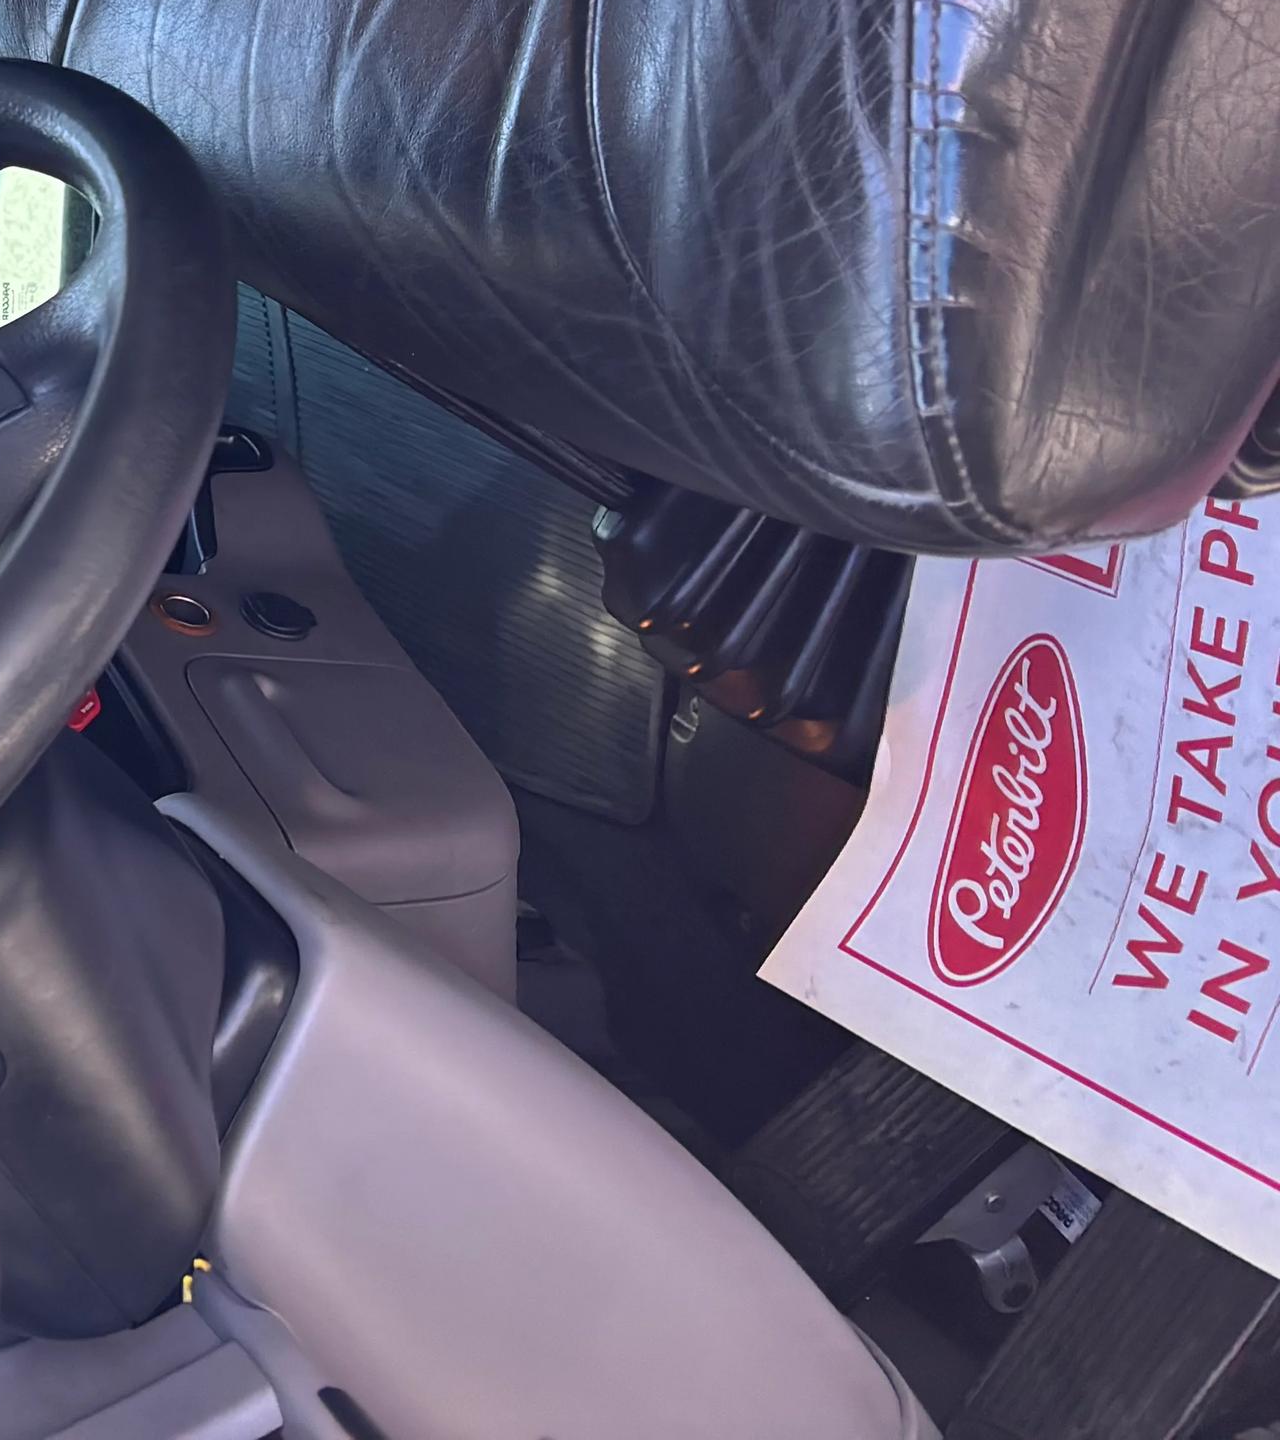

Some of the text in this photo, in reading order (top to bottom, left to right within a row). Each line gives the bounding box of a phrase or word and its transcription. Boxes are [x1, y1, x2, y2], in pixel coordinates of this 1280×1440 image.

[947, 657, 1058, 950] Peterbilt
[1111, 852, 1209, 990] WE
[1166, 606, 1250, 826] TAKE
[1186, 939, 1271, 1044] IN
